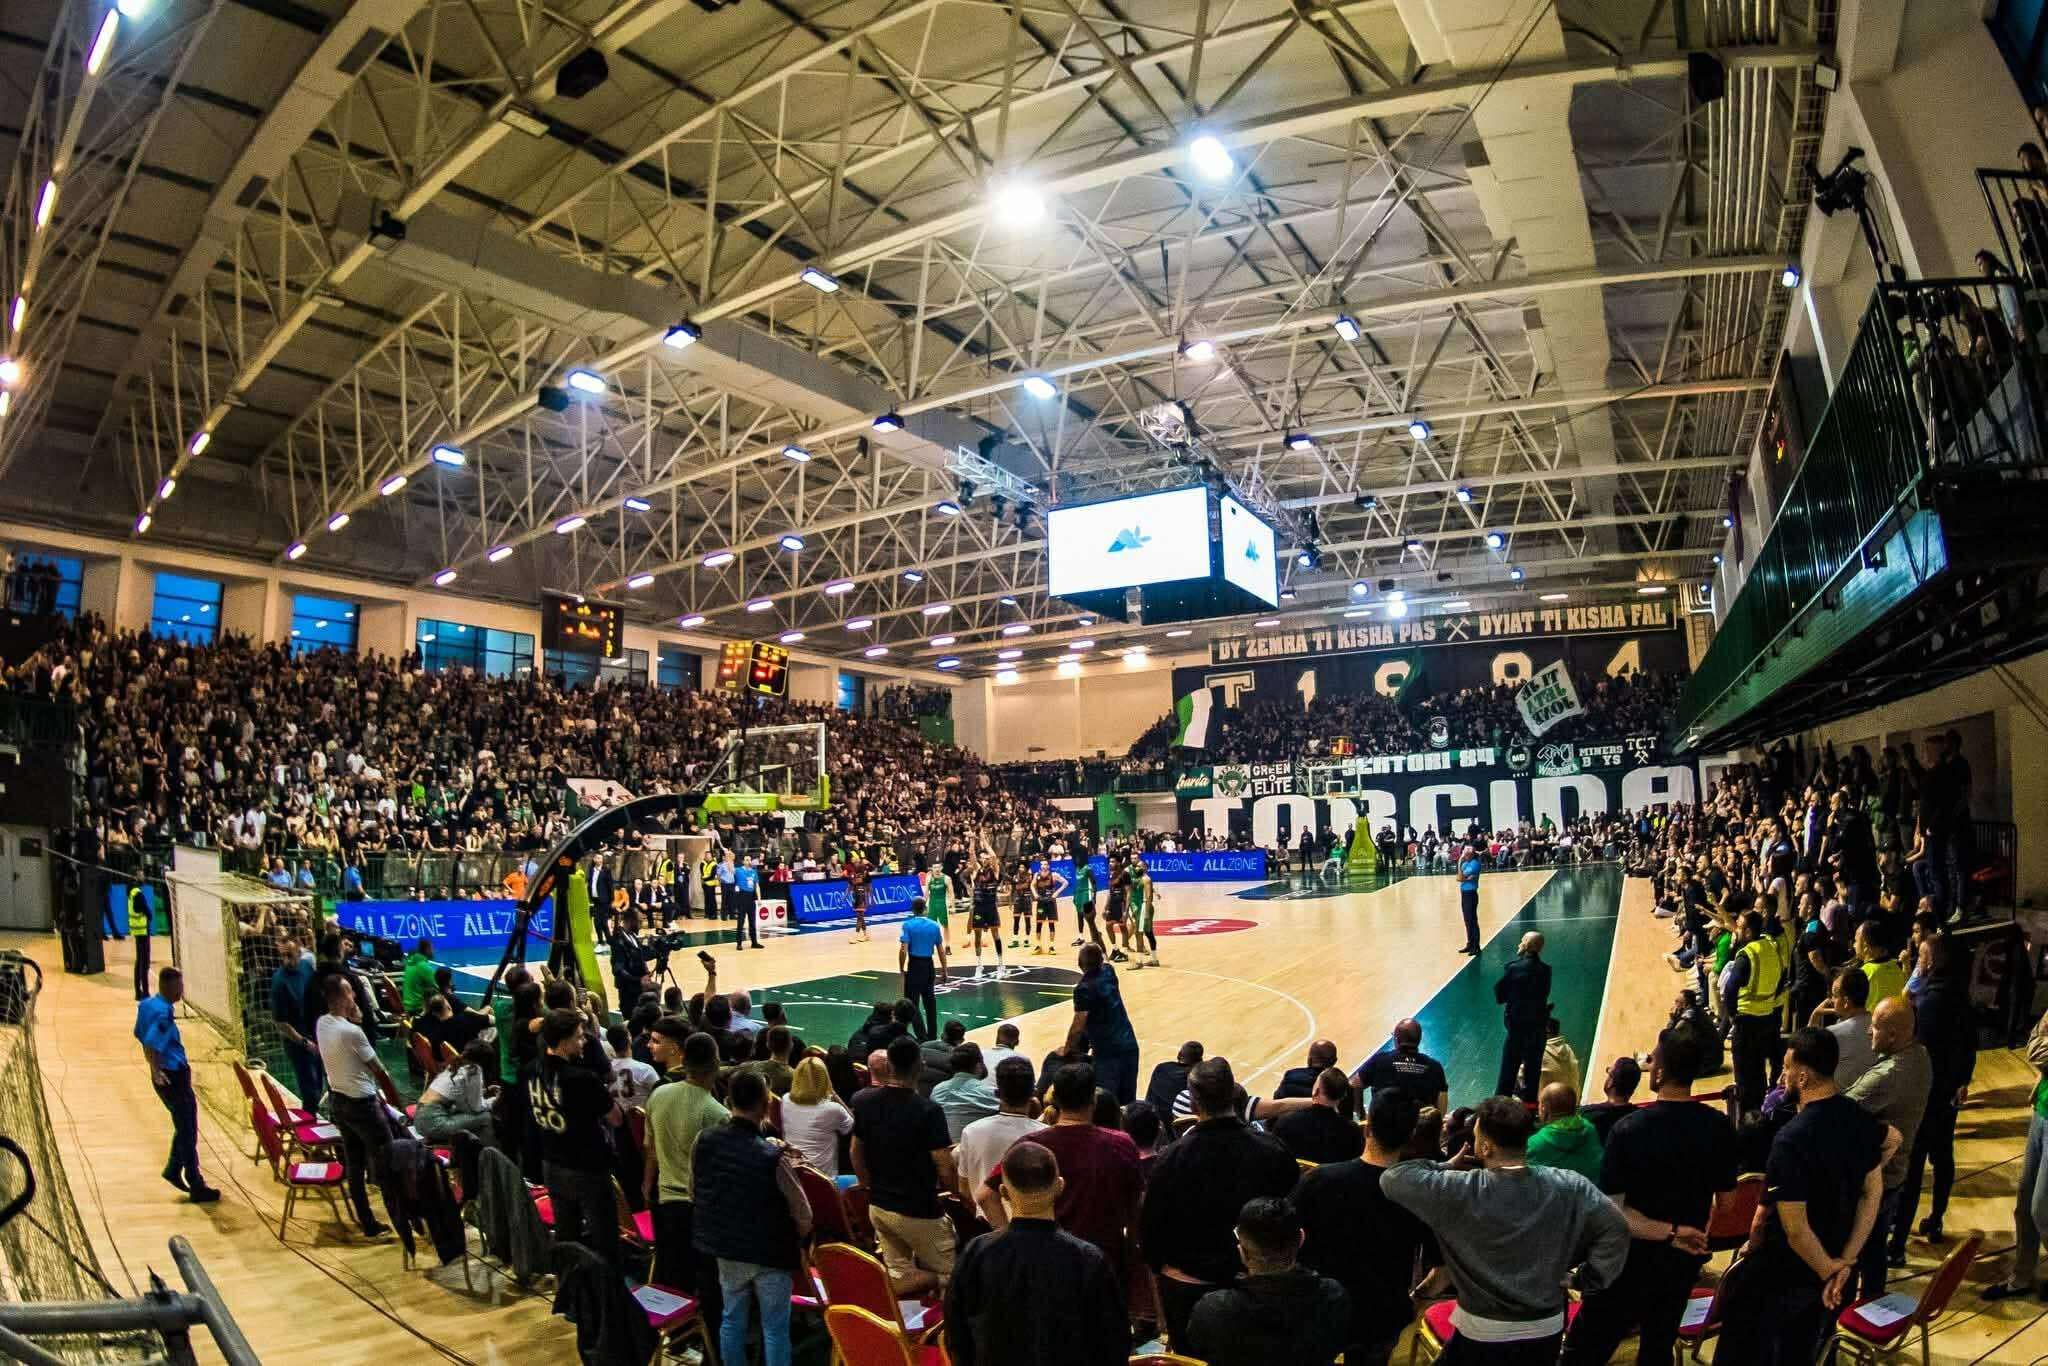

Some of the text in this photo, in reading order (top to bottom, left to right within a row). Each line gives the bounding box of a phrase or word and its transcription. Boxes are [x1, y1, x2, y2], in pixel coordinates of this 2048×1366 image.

[1219, 602, 1668, 660] DY ZEMRA TI KISHA PAS DYJAT TI KISHA FAL
[1252, 763, 1291, 777] GREEN
[1254, 779, 1292, 796] ELITE
[1203, 855, 1257, 872] ALLZONE
[464, 910, 551, 936] ALLZNE
